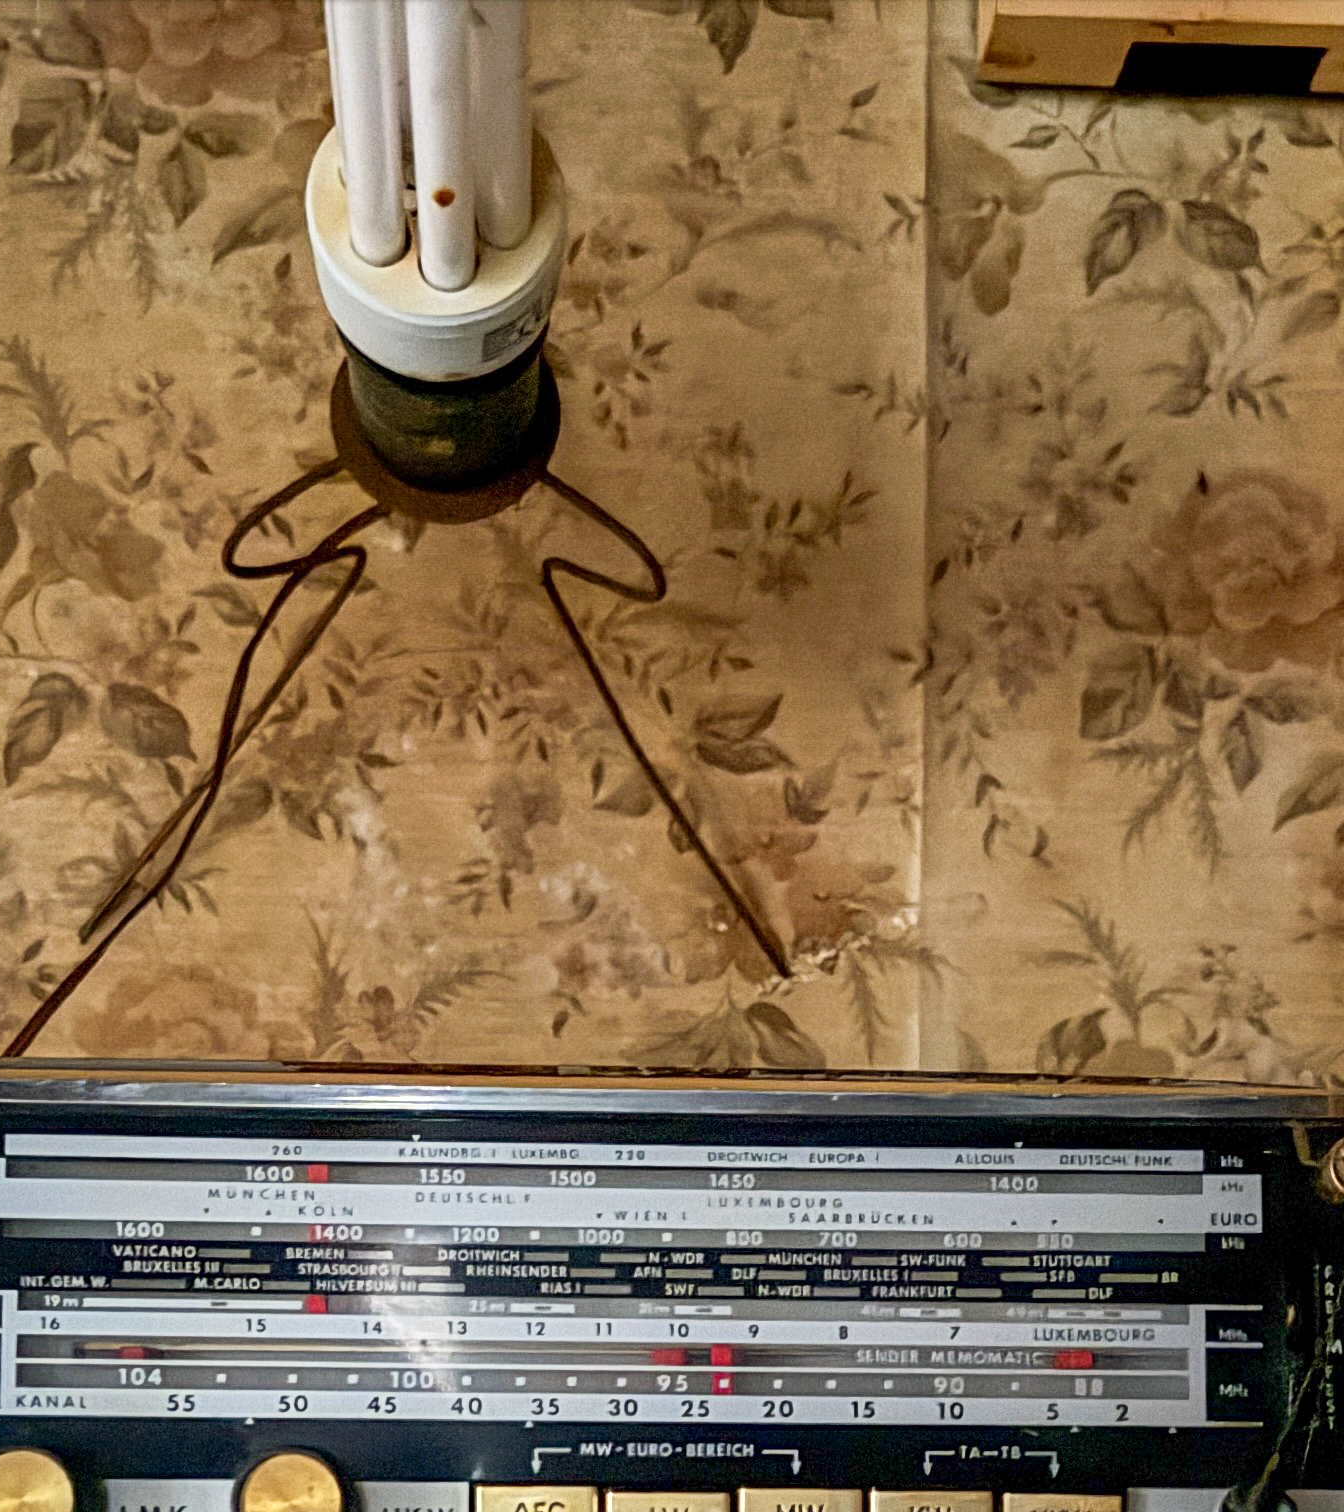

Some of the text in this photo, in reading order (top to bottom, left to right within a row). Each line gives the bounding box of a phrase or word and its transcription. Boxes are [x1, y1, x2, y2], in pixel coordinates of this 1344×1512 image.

[707, 1151, 788, 1163] DROITWICH
[809, 1152, 865, 1164] EUROPA
[954, 1153, 1015, 1165] ALLOUIS
[244, 1165, 295, 1181] 1600
[419, 1168, 465, 1184] 1550
[549, 1170, 597, 1186] 1500
[709, 1173, 755, 1189] 1450
[989, 1176, 1039, 1192] 1400
[707, 1196, 844, 1209] LUXEMBOURG
[614, 1209, 668, 1222] WIEN
[1210, 1212, 1258, 1227] EURO
[115, 1221, 165, 1238] 1600
[314, 1225, 364, 1242] 1400
[452, 1227, 500, 1244] 1200
[577, 1229, 625, 1245] 1000
[725, 1231, 764, 1246] 800
[819, 1231, 858, 1248] 700
[943, 1233, 983, 1249] 600
[112, 1244, 197, 1258] VATICANO
[285, 1247, 346, 1260] BREMEN
[437, 1249, 521, 1262] DROITWICH
[122, 1260, 201, 1274] BRUXELLES
[900, 1253, 966, 1267] SW-FUNK
[1032, 1255, 1112, 1268] STUTTGART
[297, 1262, 390, 1277] STRASBOURG
[465, 1264, 568, 1279] RHEINSENDER
[823, 1268, 899, 1283] BRUXELLES
[316, 1279, 397, 1293] HILVERSUM
[540, 1281, 572, 1295] RIAS
[664, 1282, 695, 1296] SWF
[871, 1285, 954, 1299] FRANKFURT
[40, 1316, 61, 1331] 16
[245, 1318, 267, 1333] 15
[362, 1320, 383, 1335] 14
[447, 1320, 468, 1336] 13
[525, 1321, 546, 1337] 12
[595, 1322, 613, 1337] 11
[668, 1323, 690, 1338] 10
[748, 1324, 760, 1339] 9
[838, 1325, 849, 1340] 8
[949, 1326, 961, 1340] 7
[1033, 1327, 1156, 1342] LUXEMBOURG
[856, 1349, 1041, 1366] SENDER MEMOMATIC
[117, 1367, 162, 1386] 104
[390, 1371, 435, 1390] 100
[656, 1374, 689, 1393] 95
[933, 1376, 966, 1395] 90
[15, 1394, 87, 1410] KANAL
[166, 1394, 196, 1412] 55
[277, 1395, 309, 1413] 50
[366, 1396, 398, 1414] 45
[450, 1397, 483, 1415] 40
[530, 1398, 560, 1416] 35
[608, 1399, 639, 1417] 30
[680, 1400, 710, 1418] 25
[762, 1400, 795, 1419] 20
[850, 1401, 876, 1419] 15
[937, 1402, 965, 1420] 10
[1046, 1403, 1059, 1421] 5
[1115, 1404, 1130, 1422] 2
